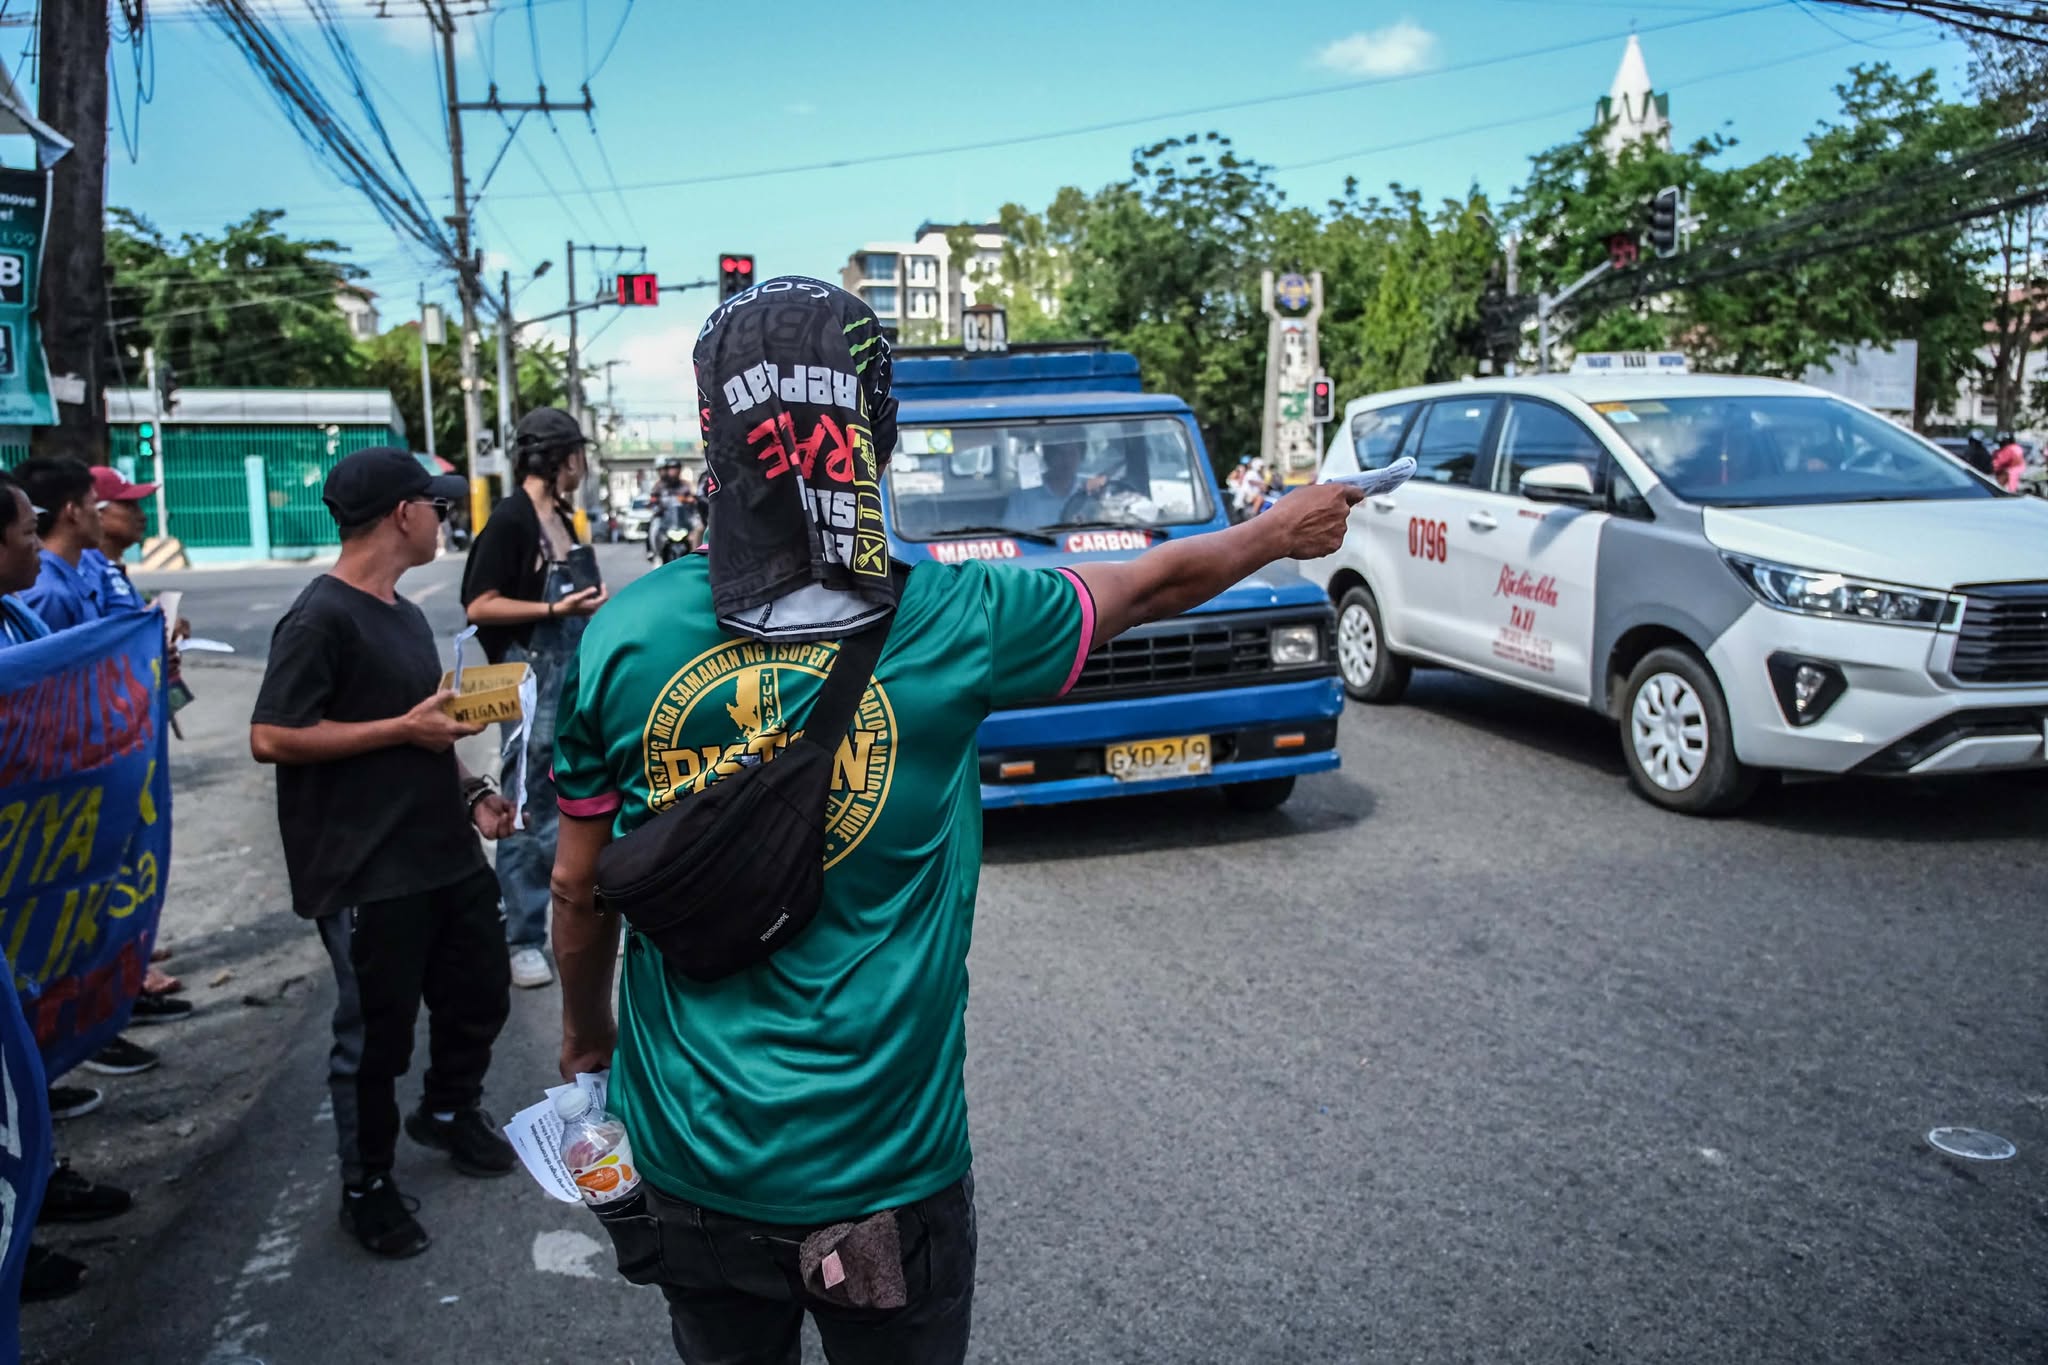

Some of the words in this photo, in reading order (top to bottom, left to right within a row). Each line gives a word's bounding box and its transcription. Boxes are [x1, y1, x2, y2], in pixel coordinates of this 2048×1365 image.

[936, 539, 1016, 563] MABOLO
[1068, 532, 1149, 553] CARBON
[1408, 516, 1447, 564] 0796
[743, 643, 766, 664] NG
[771, 643, 830, 668] TSUPER
[669, 649, 742, 707] SAMAHAN
[762, 673, 776, 727] TUNAY
[652, 703, 680, 740] MGA
[661, 730, 877, 796] PISTN
[858, 746, 888, 802] NATION
[834, 801, 873, 843] WIDE
